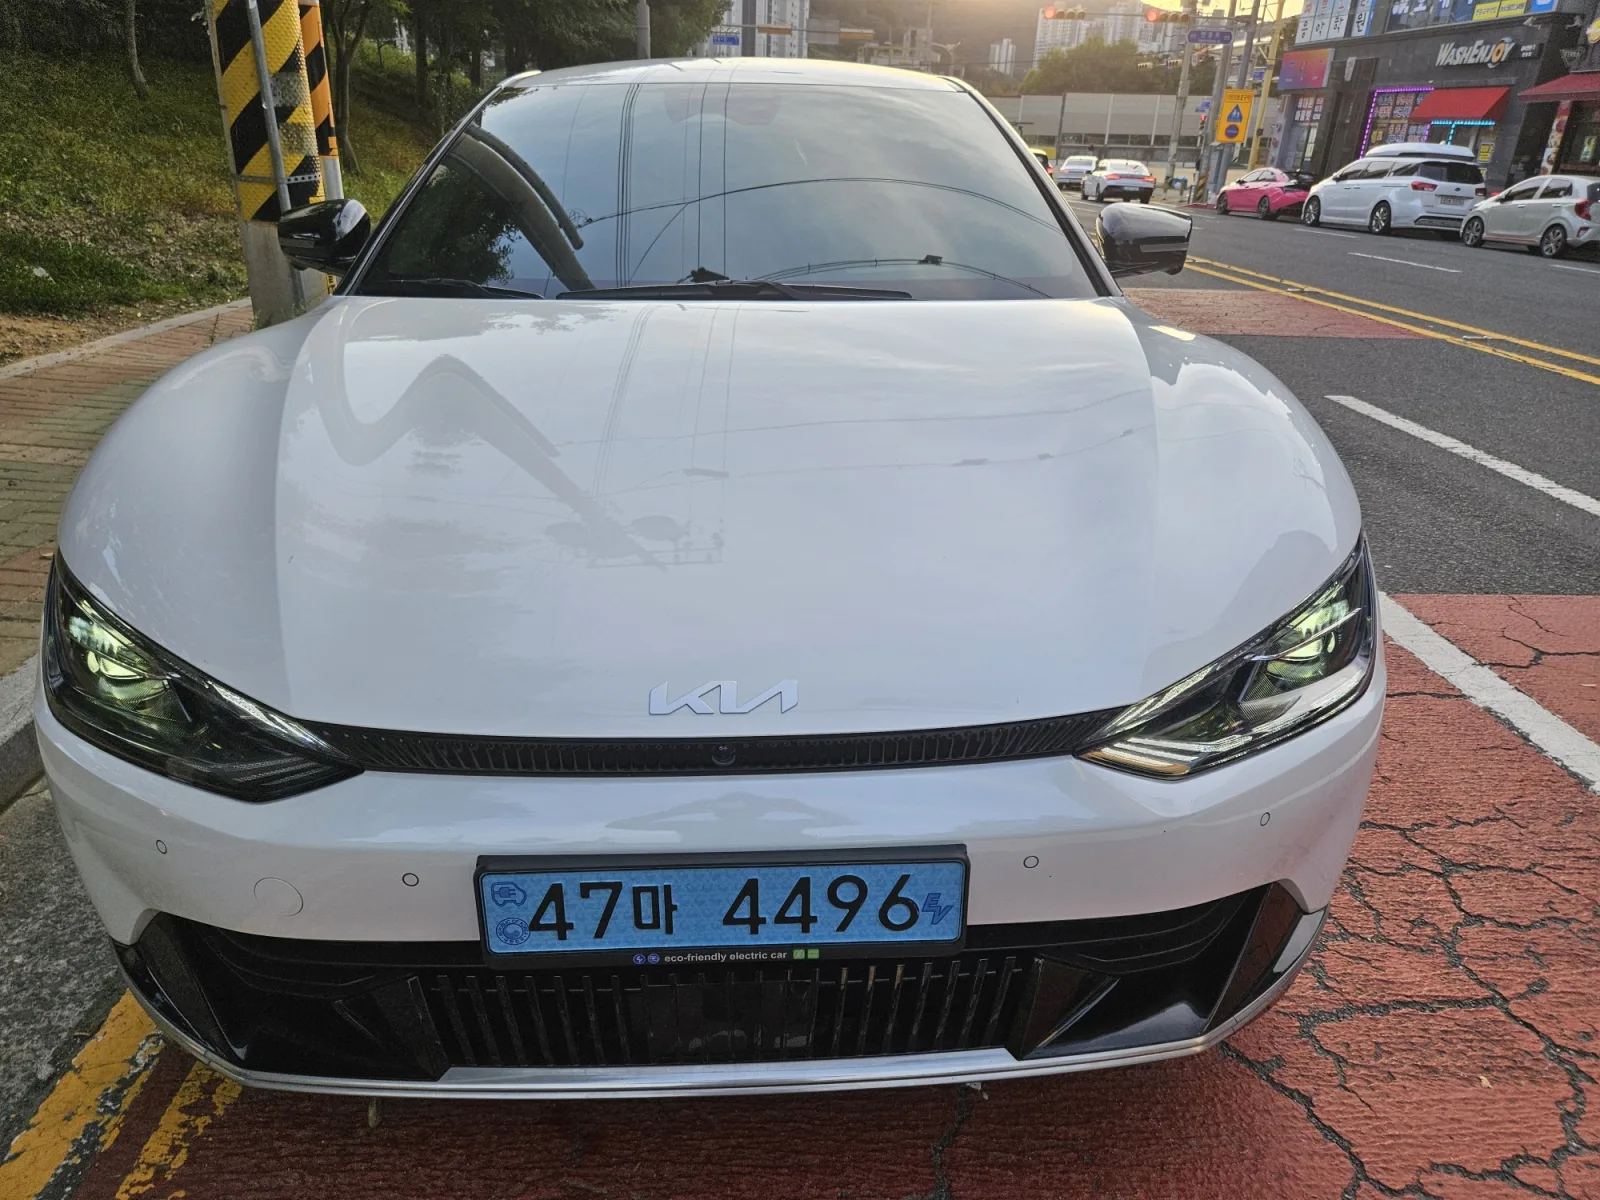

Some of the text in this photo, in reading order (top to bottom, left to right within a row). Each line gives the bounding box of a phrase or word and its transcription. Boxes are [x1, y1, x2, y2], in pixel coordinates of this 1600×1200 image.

[649, 679, 798, 715] KIA
[528, 882, 678, 940] 47마
[723, 874, 919, 934] 4496
[922, 892, 954, 926] EV
[664, 952, 787, 963] eco-friendly electric car
